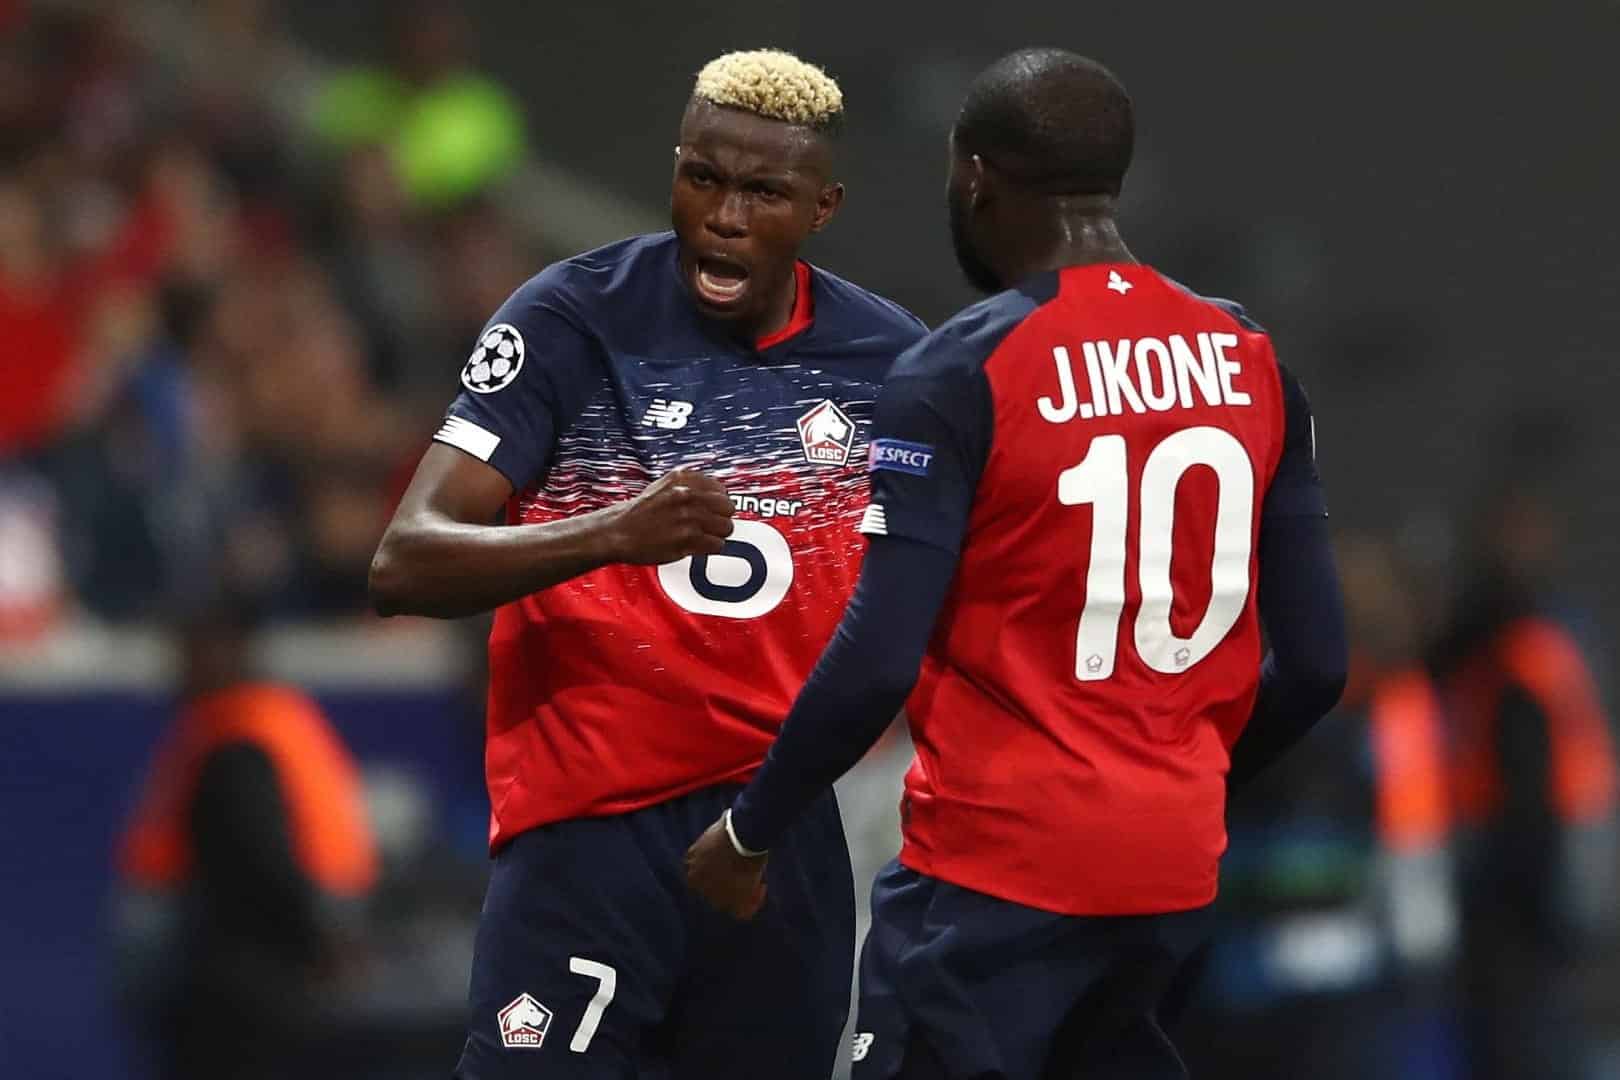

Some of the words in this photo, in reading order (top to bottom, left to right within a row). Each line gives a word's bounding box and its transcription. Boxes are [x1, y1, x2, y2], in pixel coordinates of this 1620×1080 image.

[1037, 332, 1252, 423] J.IKONE
[811, 447, 842, 460] LOSC
[875, 446, 933, 468] ESPECT
[729, 494, 803, 517] anger
[1058, 426, 1254, 680] 10
[570, 957, 616, 1052] 7
[508, 1033, 538, 1044] LOSC
